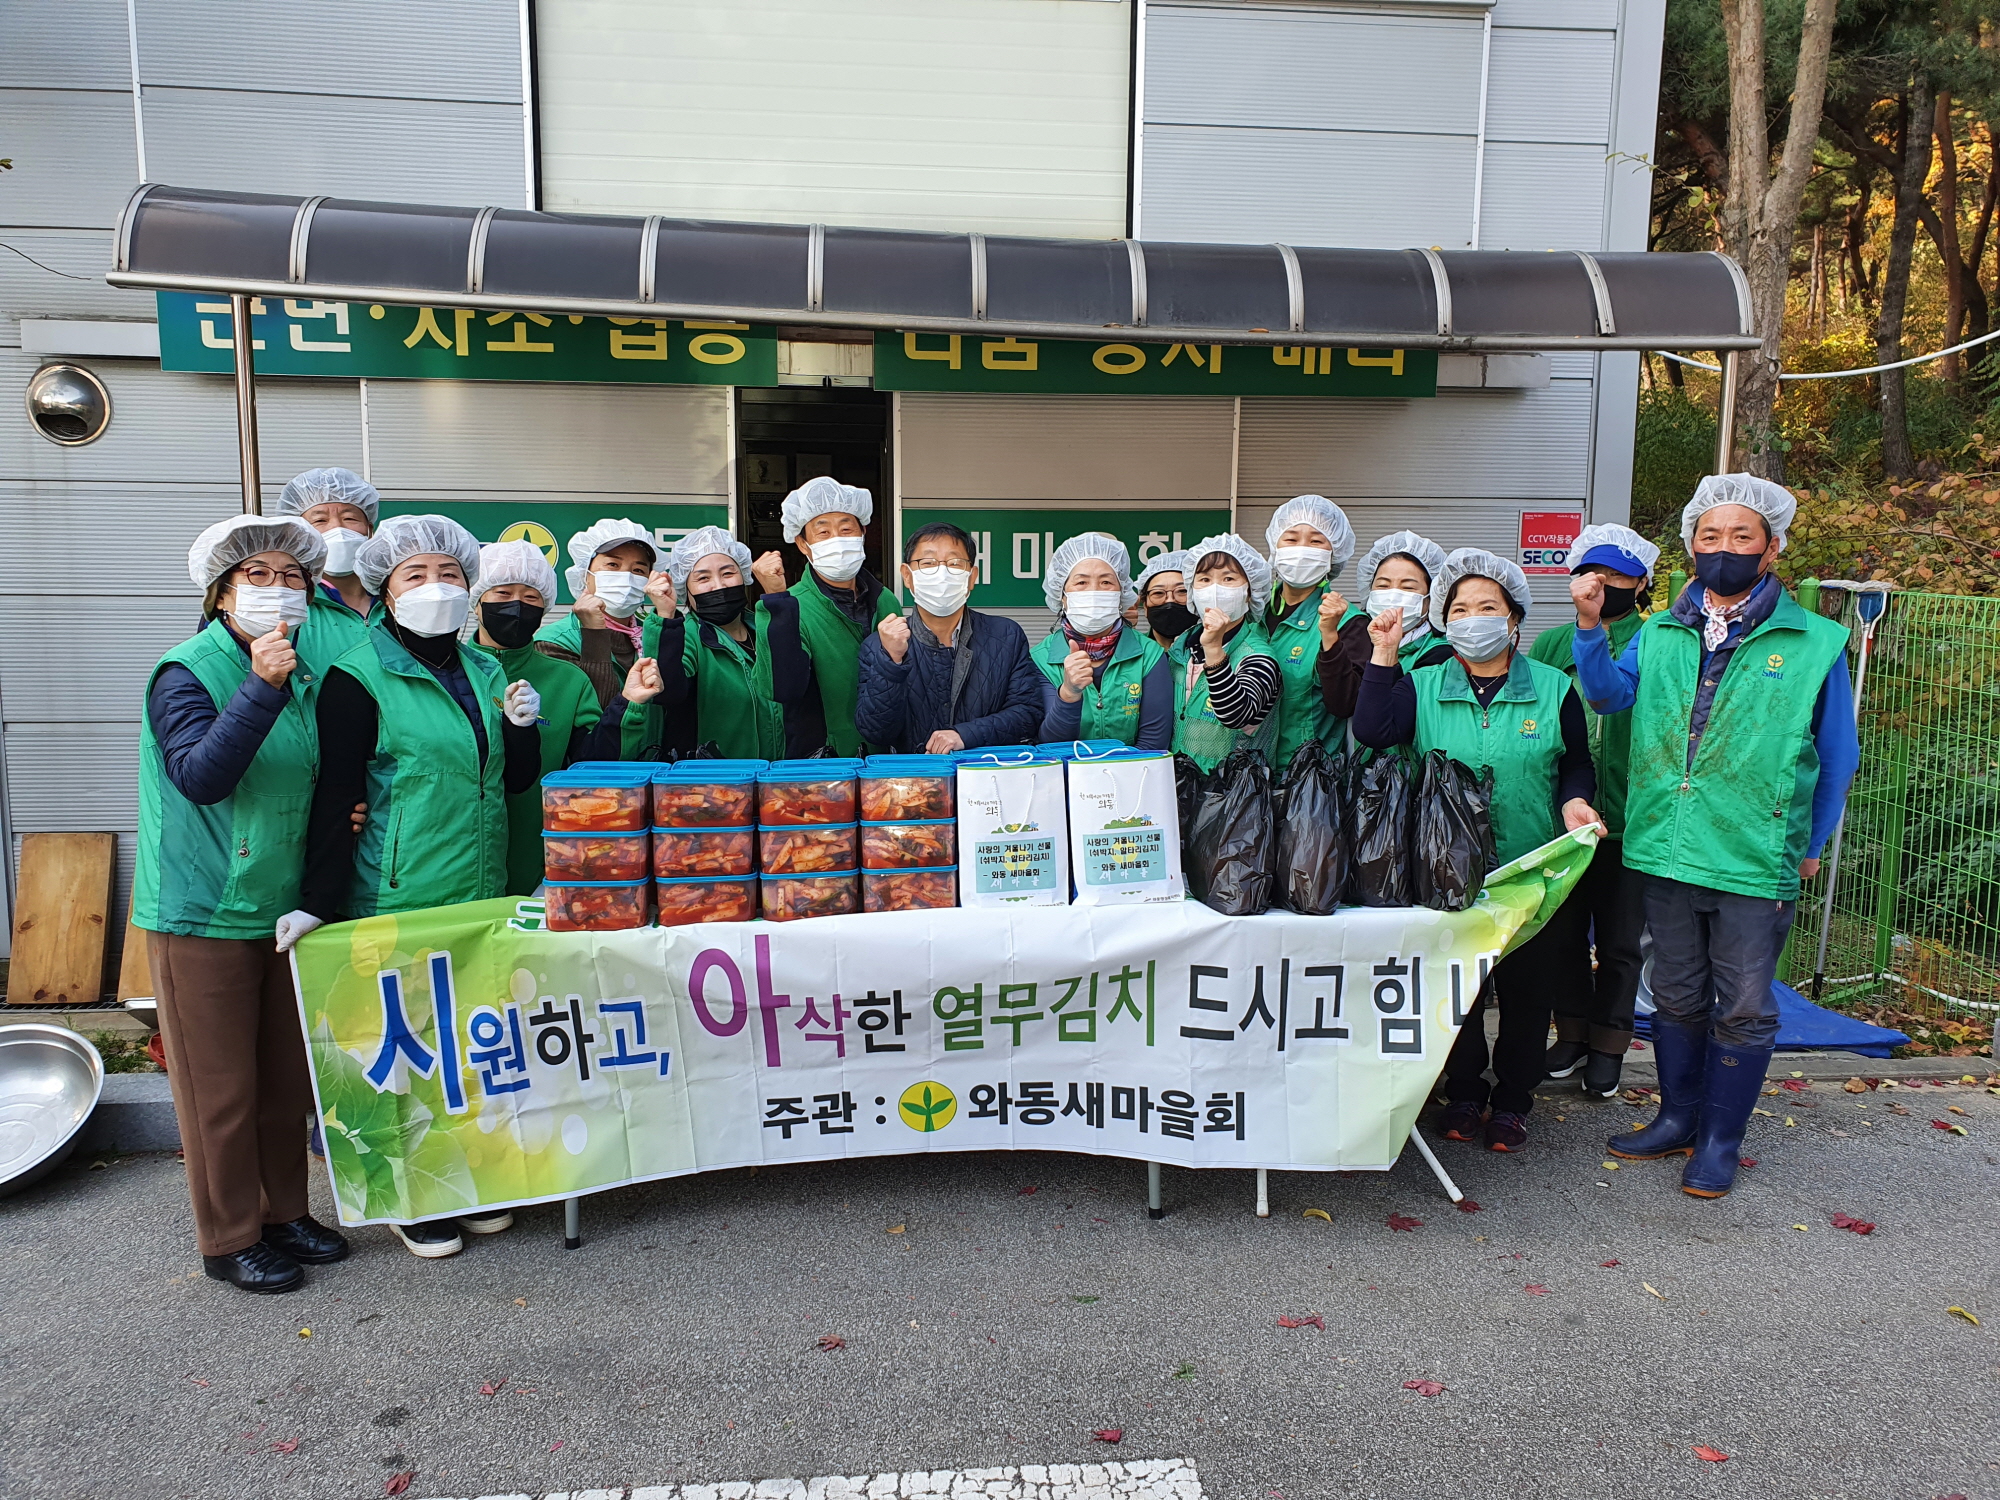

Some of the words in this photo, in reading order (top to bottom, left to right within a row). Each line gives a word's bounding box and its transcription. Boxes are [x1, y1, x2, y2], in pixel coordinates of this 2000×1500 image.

[1527, 534, 1573, 544] CCTV작동중
[1523, 550, 1568, 565] SECO
[1762, 670, 1784, 680] SMU
[1086, 838, 1109, 847] 사랑의
[1112, 836, 1143, 845] 겨울나기
[1146, 833, 1161, 842] 선물
[977, 845, 1001, 854] 사랑의
[1004, 843, 1034, 852] 겨울나기
[1037, 841, 1052, 850] 선물
[1101, 862, 1117, 872] 와동
[1120, 859, 1150, 870] 새마을회
[991, 870, 1007, 879] 와동
[1010, 868, 1040, 878] 새마을회
[363, 951, 672, 1112] 시원하고,
[688, 933, 912, 1068] 아삭한
[932, 959, 1157, 1052] 열무김치
[1179, 957, 1350, 1053] 드시고
[1372, 956, 1423, 1054] 힘
[762, 1090, 857, 1139] 주관
[968, 1080, 1246, 1141] 와동새마을회
